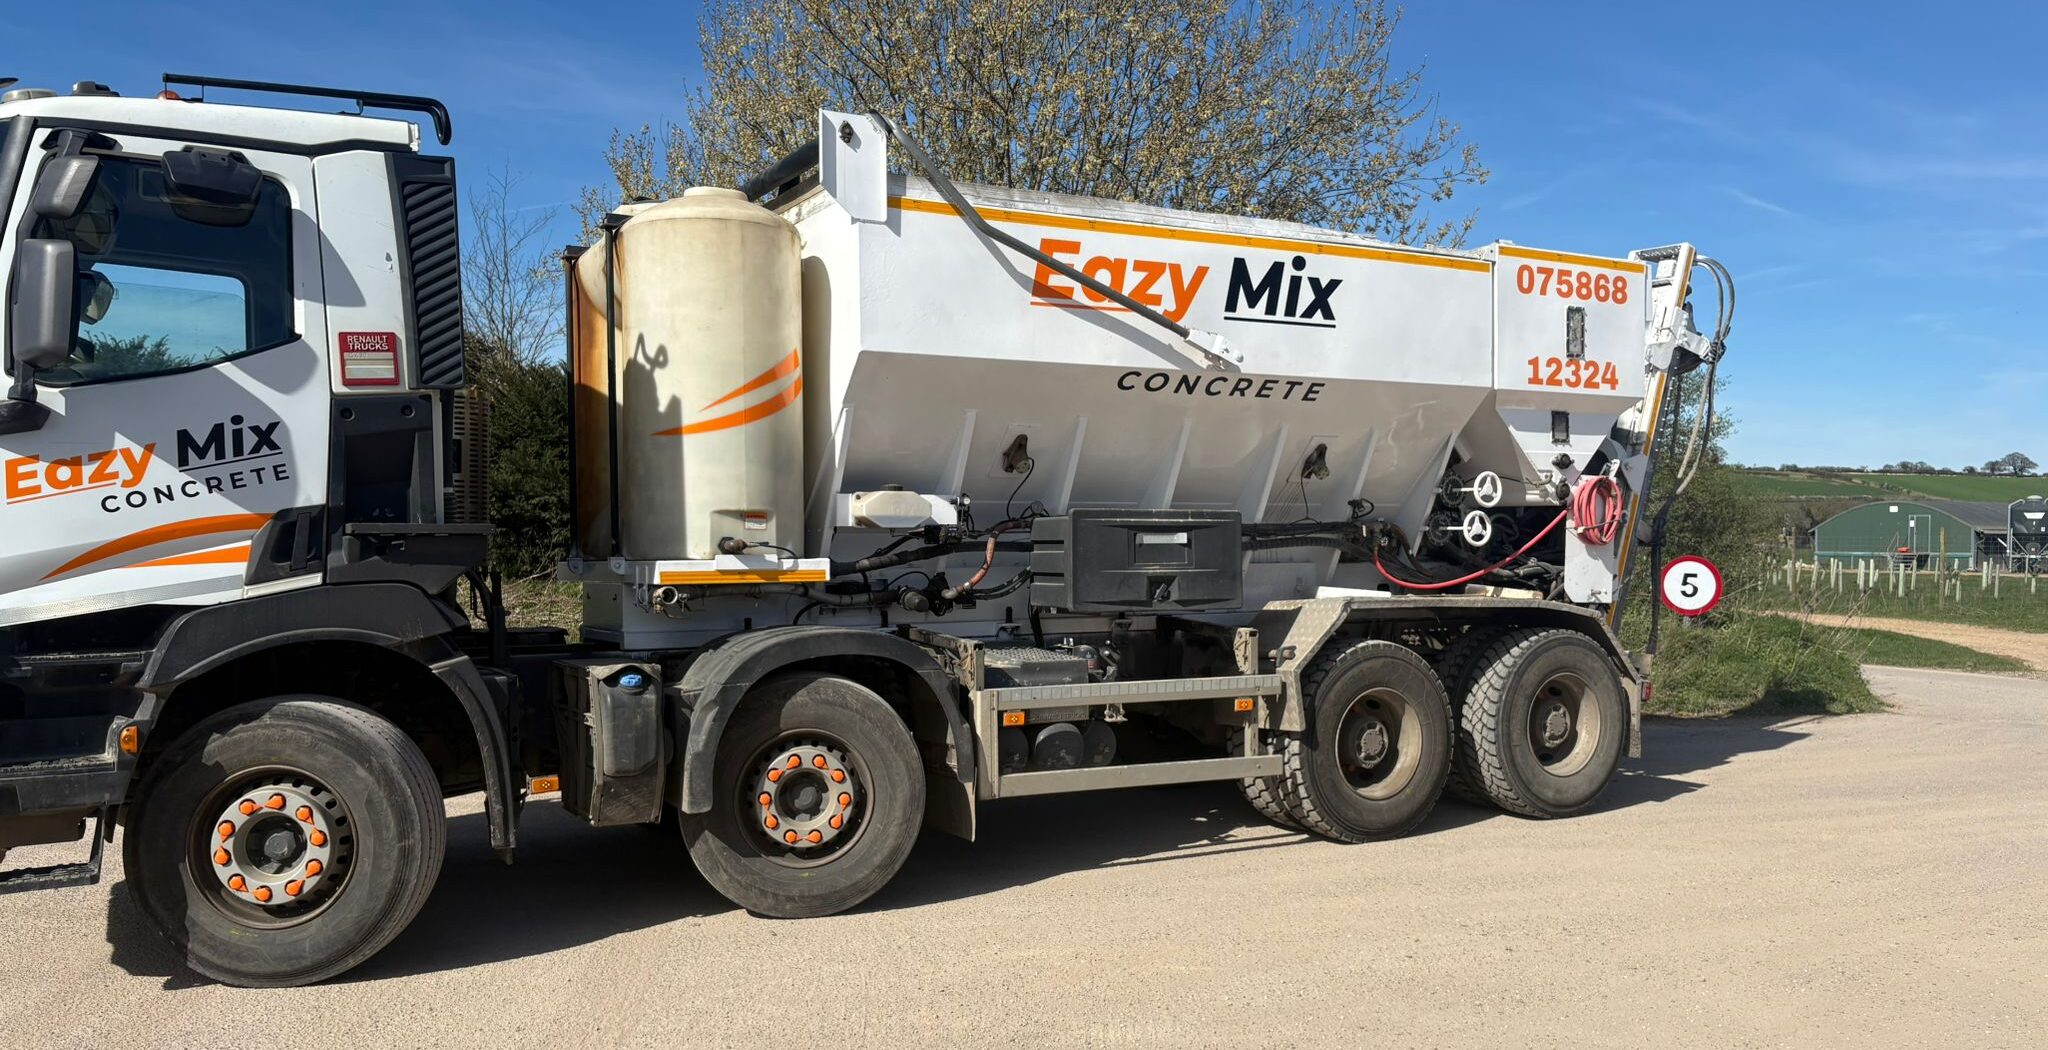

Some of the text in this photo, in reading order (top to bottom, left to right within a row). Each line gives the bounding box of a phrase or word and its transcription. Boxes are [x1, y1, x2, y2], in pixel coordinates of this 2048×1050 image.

[1031, 238, 1343, 324] Eazy Mix
[1516, 264, 1628, 305] 075868
[347, 335, 388, 343] RENAULT
[349, 342, 389, 351] TRUCKS
[1117, 371, 1325, 402] CONCRETE
[1528, 356, 1619, 391] 12324
[4, 414, 281, 500] Eazy Mix
[100, 463, 290, 513] CONCRETE
[1680, 573, 1699, 598] 5
